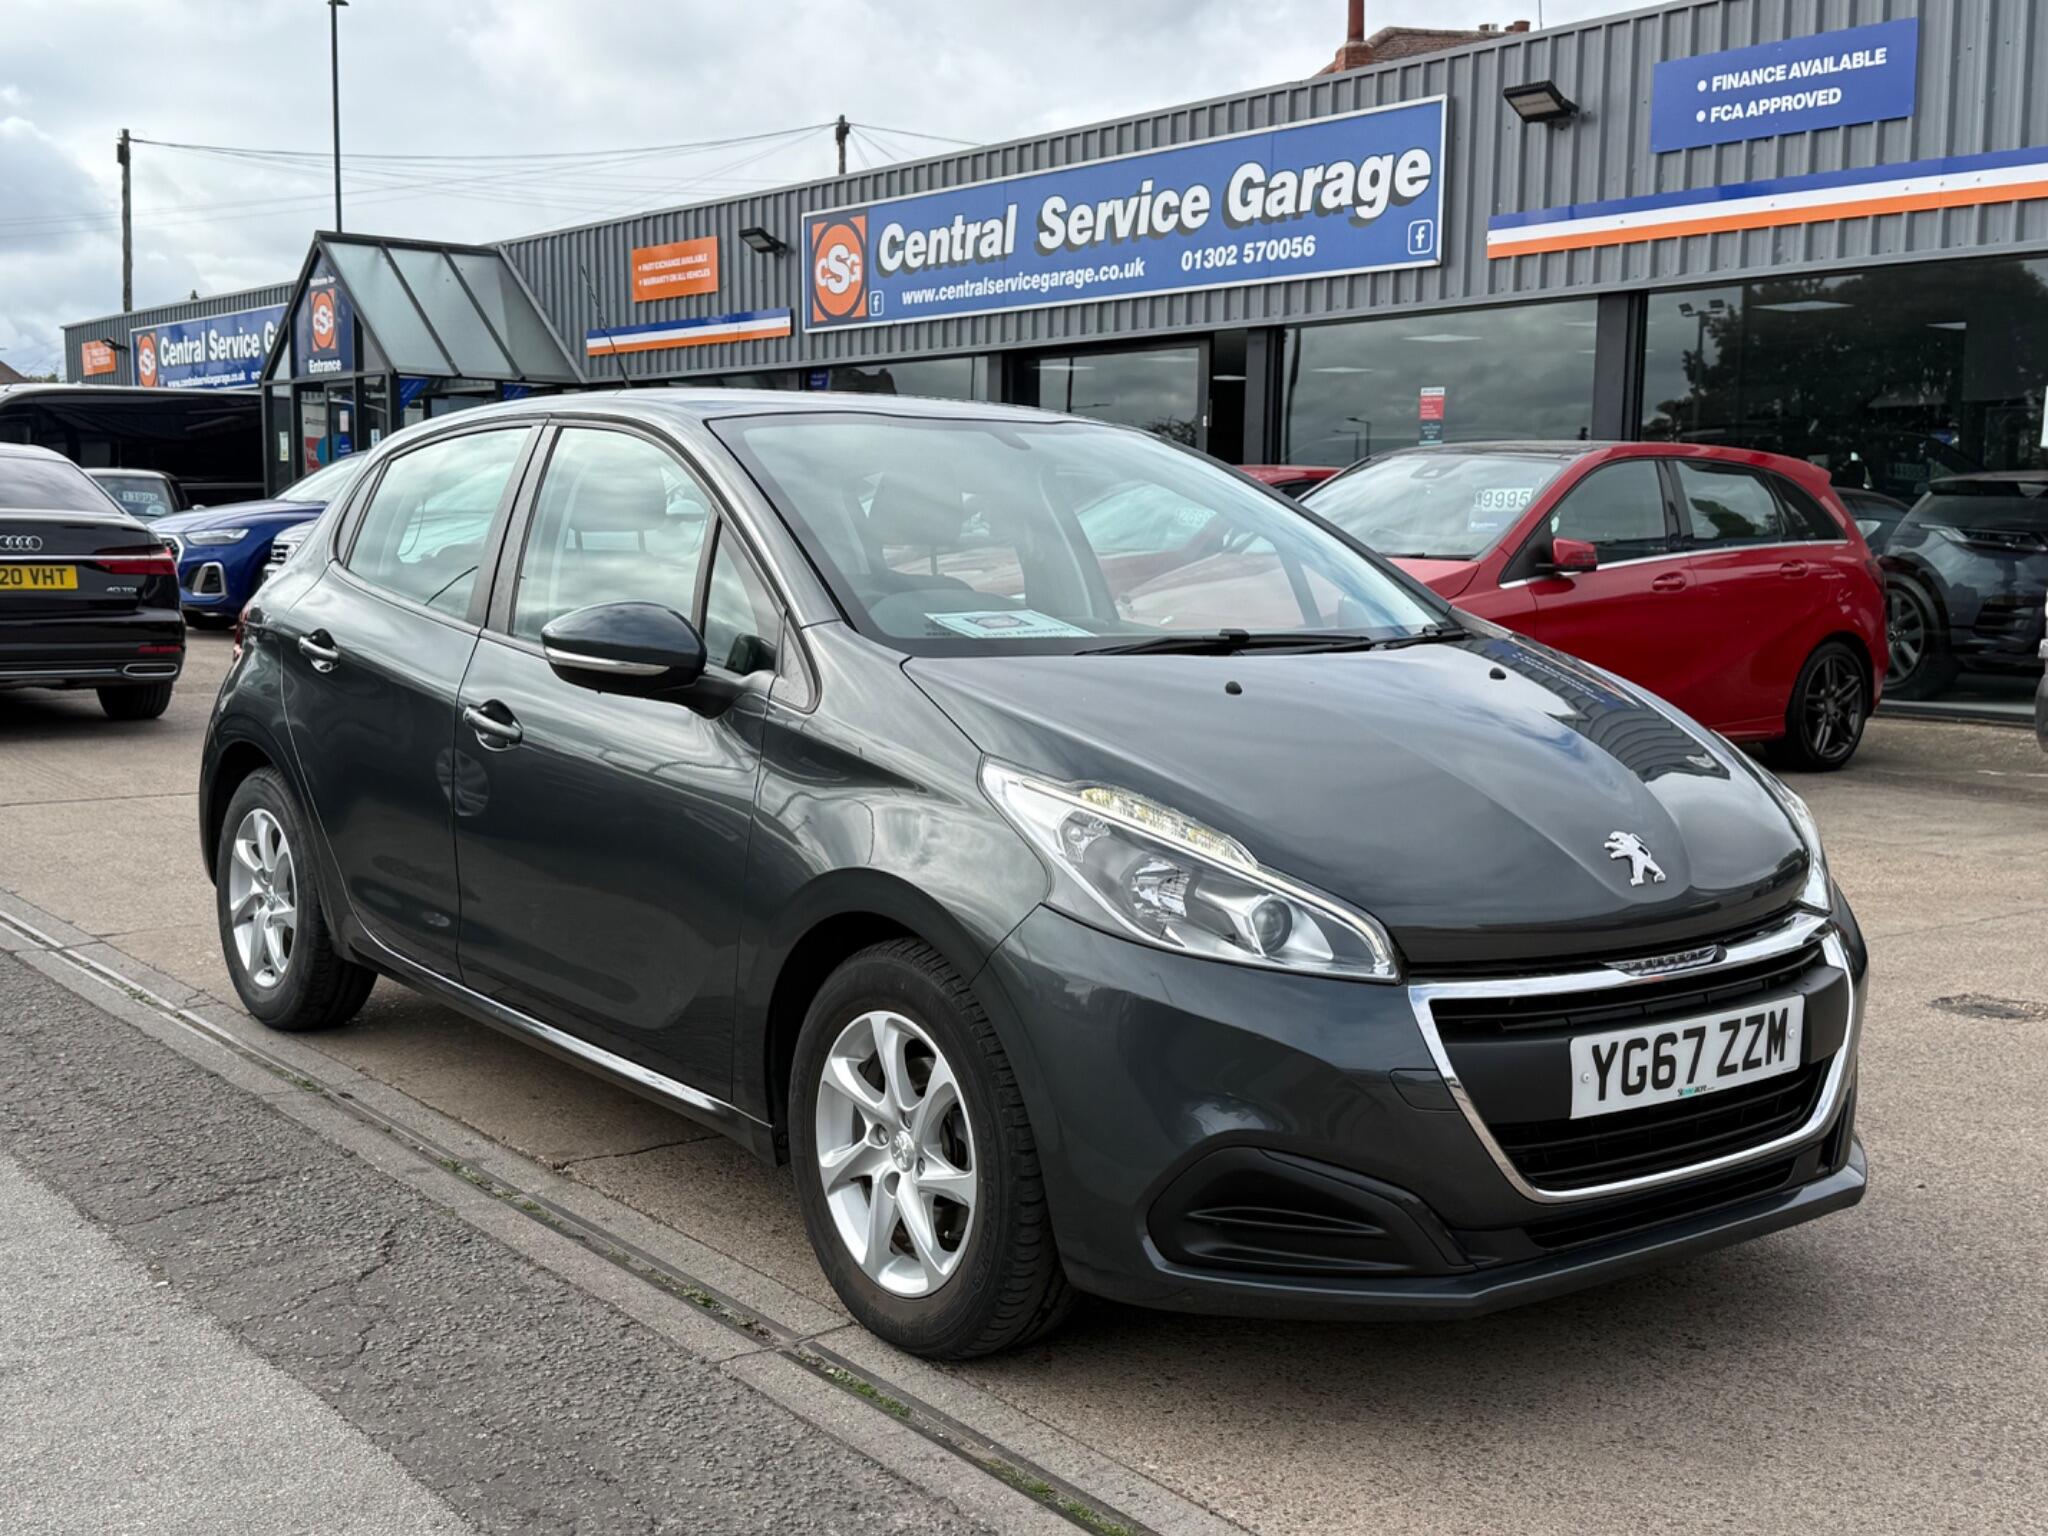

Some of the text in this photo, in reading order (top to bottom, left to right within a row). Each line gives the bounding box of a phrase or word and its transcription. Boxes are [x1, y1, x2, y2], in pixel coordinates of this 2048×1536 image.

[1711, 47, 1888, 92] FINANCE AVAILABLE
[1710, 87, 1842, 123] FCA APPROVED
[878, 148, 1432, 272] Central Service Garage
[814, 244, 863, 294] CSG
[1180, 234, 1316, 271] 01302 570056
[901, 256, 1145, 305] www.centralservicegarage.co.uk
[160, 331, 206, 367] Central
[208, 326, 260, 361] Service
[309, 359, 342, 374] Entrance
[28, 567, 67, 586] VHT
[1591, 1007, 1789, 1102] YG67 ZZM
